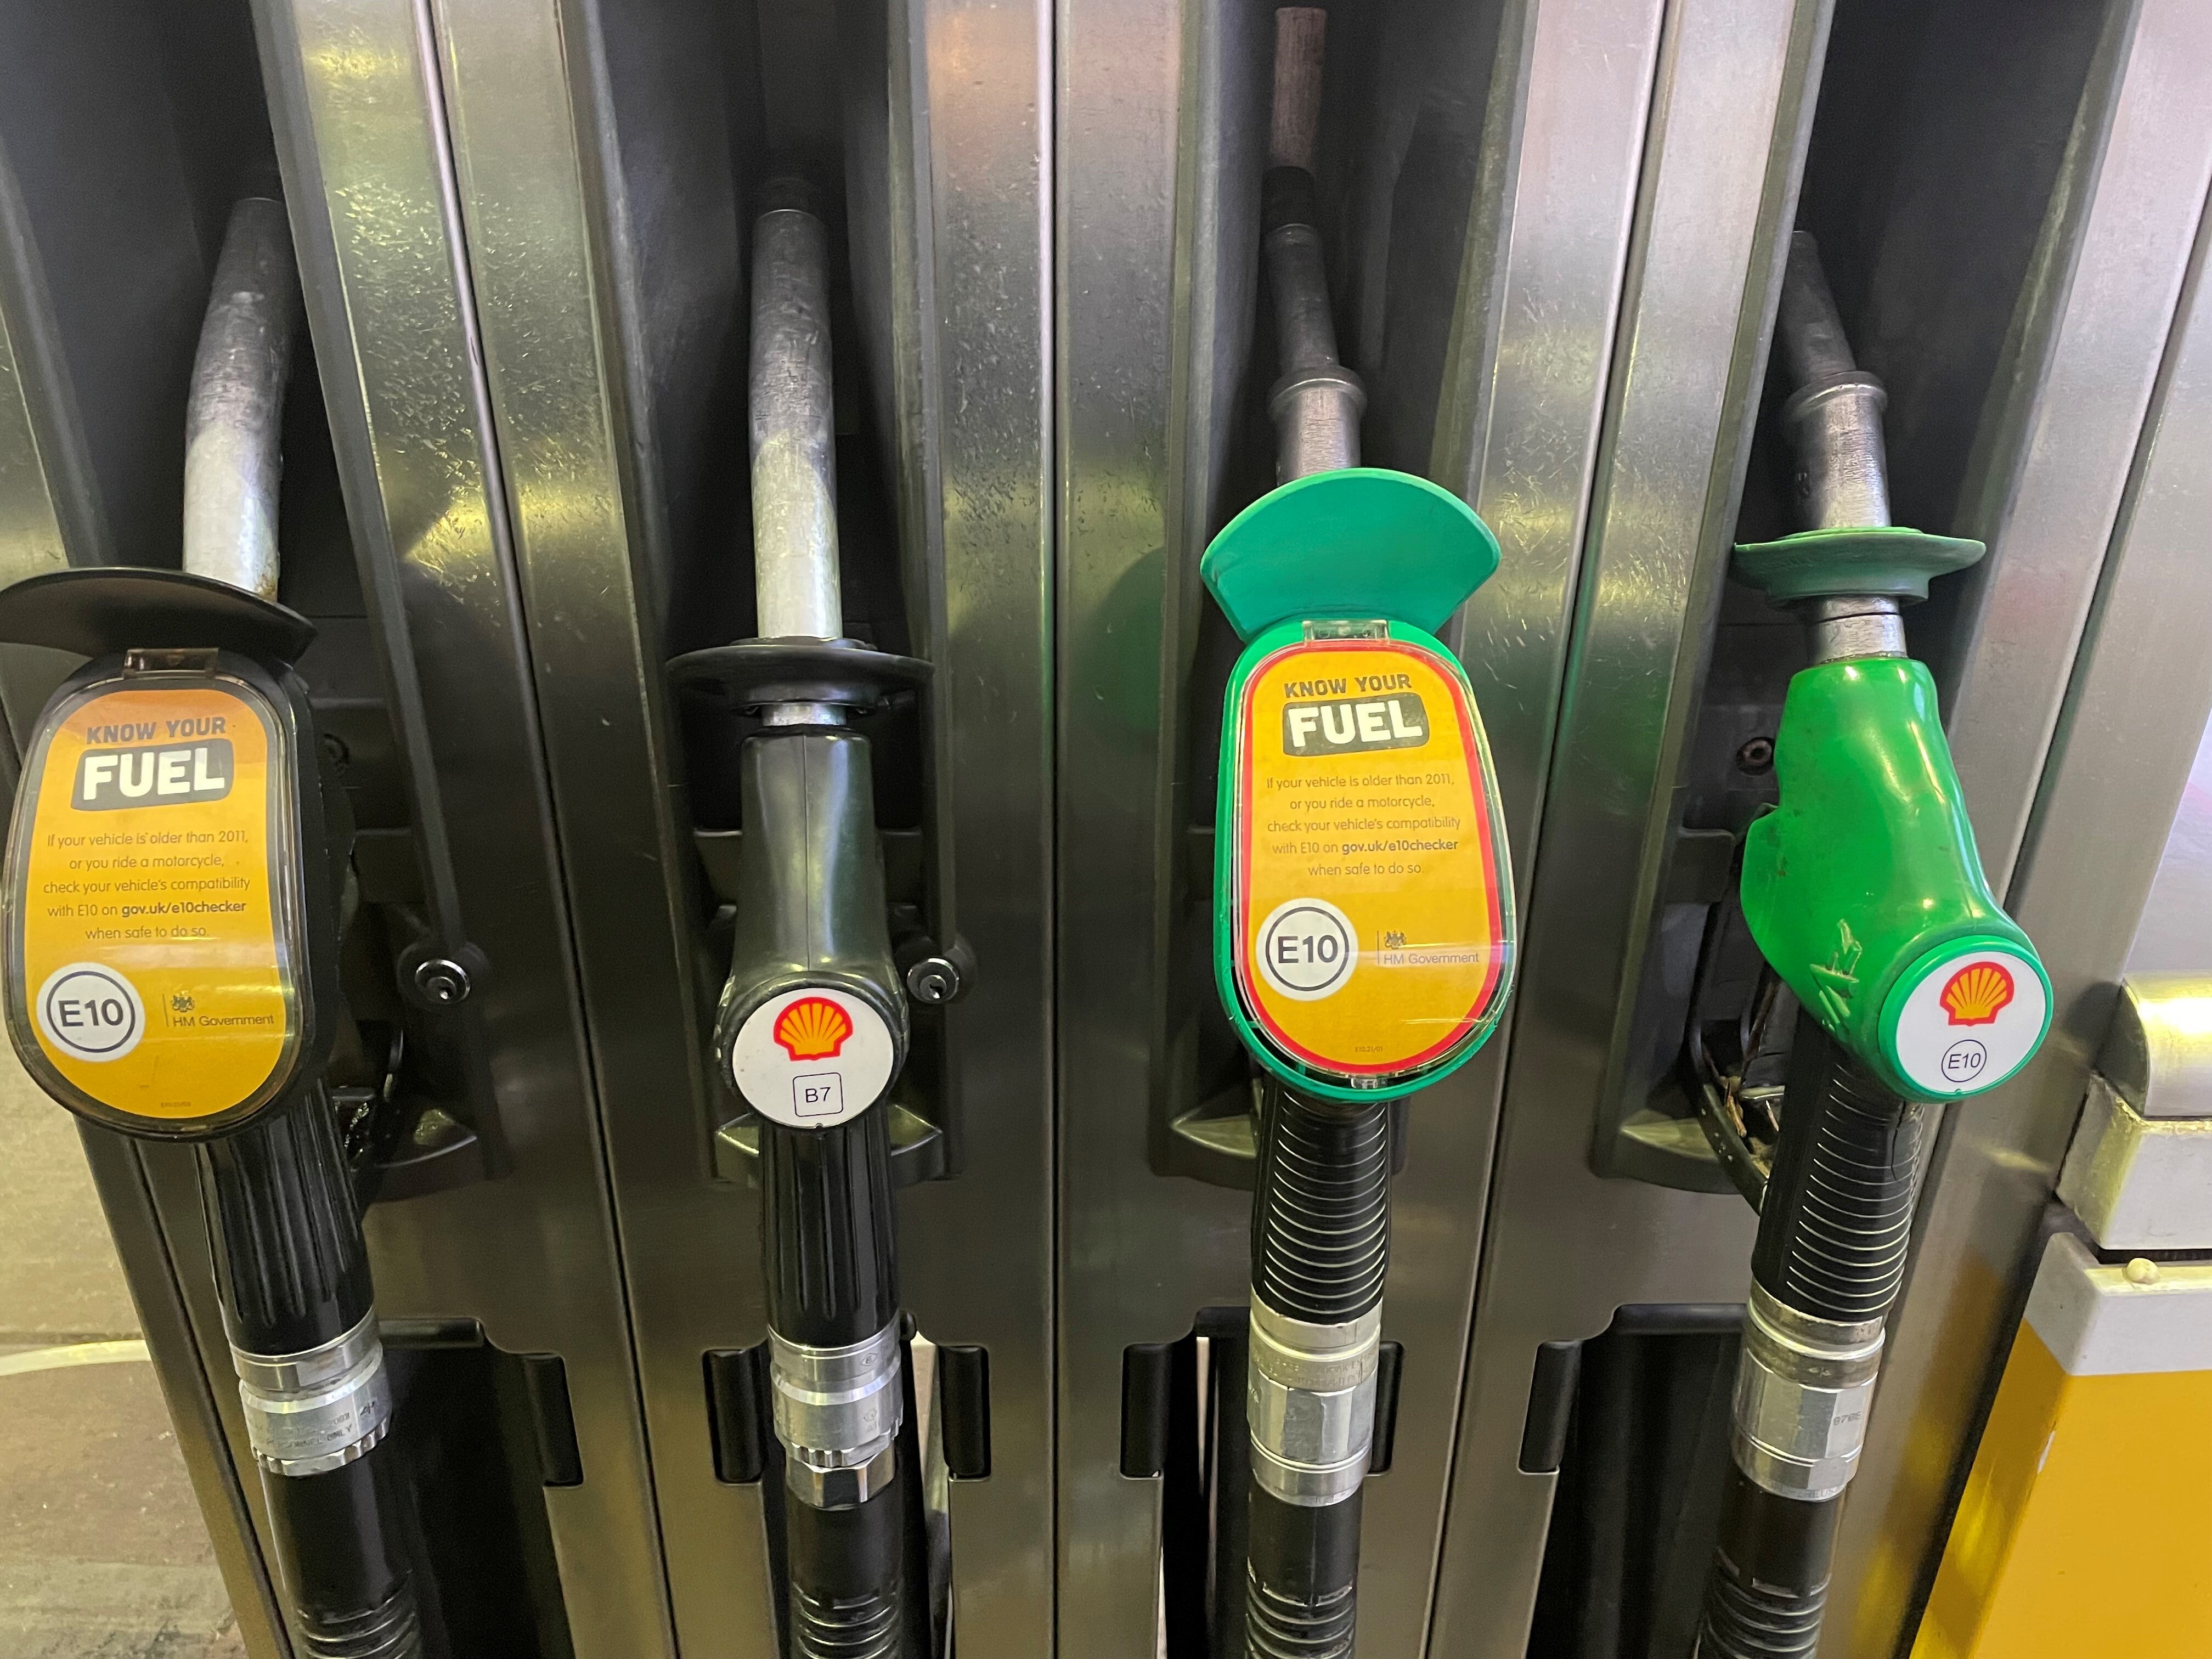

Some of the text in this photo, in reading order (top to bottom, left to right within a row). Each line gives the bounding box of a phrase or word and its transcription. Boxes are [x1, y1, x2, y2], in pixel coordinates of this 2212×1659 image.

[1284, 674, 1412, 698] KNOW YOUR
[86, 716, 226, 744] KNOW YOUR
[1288, 700, 1423, 747] FUEL
[83, 747, 225, 800] FUEL
[1267, 774, 1454, 791] If your vehicle is older than 2011,
[1290, 794, 1435, 812] or you ride a motorcycle,
[1267, 816, 1460, 833] check your vehicle's compatibility
[48, 830, 248, 849] If your vehicle is older than 2011,
[1272, 839, 1458, 855] with E10 on gov.uk/e10checker
[69, 854, 224, 872] or you ride a motorcycle,
[1308, 862, 1424, 876] when safe to do so.
[43, 877, 250, 895] check your vehicle's compatibility
[47, 900, 246, 918] with E10 on gov.uk/e10checker
[85, 927, 121, 939] when
[125, 926, 151, 938] safe
[156, 927, 167, 937] to
[171, 924, 187, 937] do
[1278, 934, 1338, 963] E10
[1384, 952, 1479, 964] HM Government
[58, 998, 124, 1027] E10
[173, 1014, 274, 1027] HM Government
[1948, 1053, 1981, 1069] E10
[805, 1087, 831, 1103] B7
